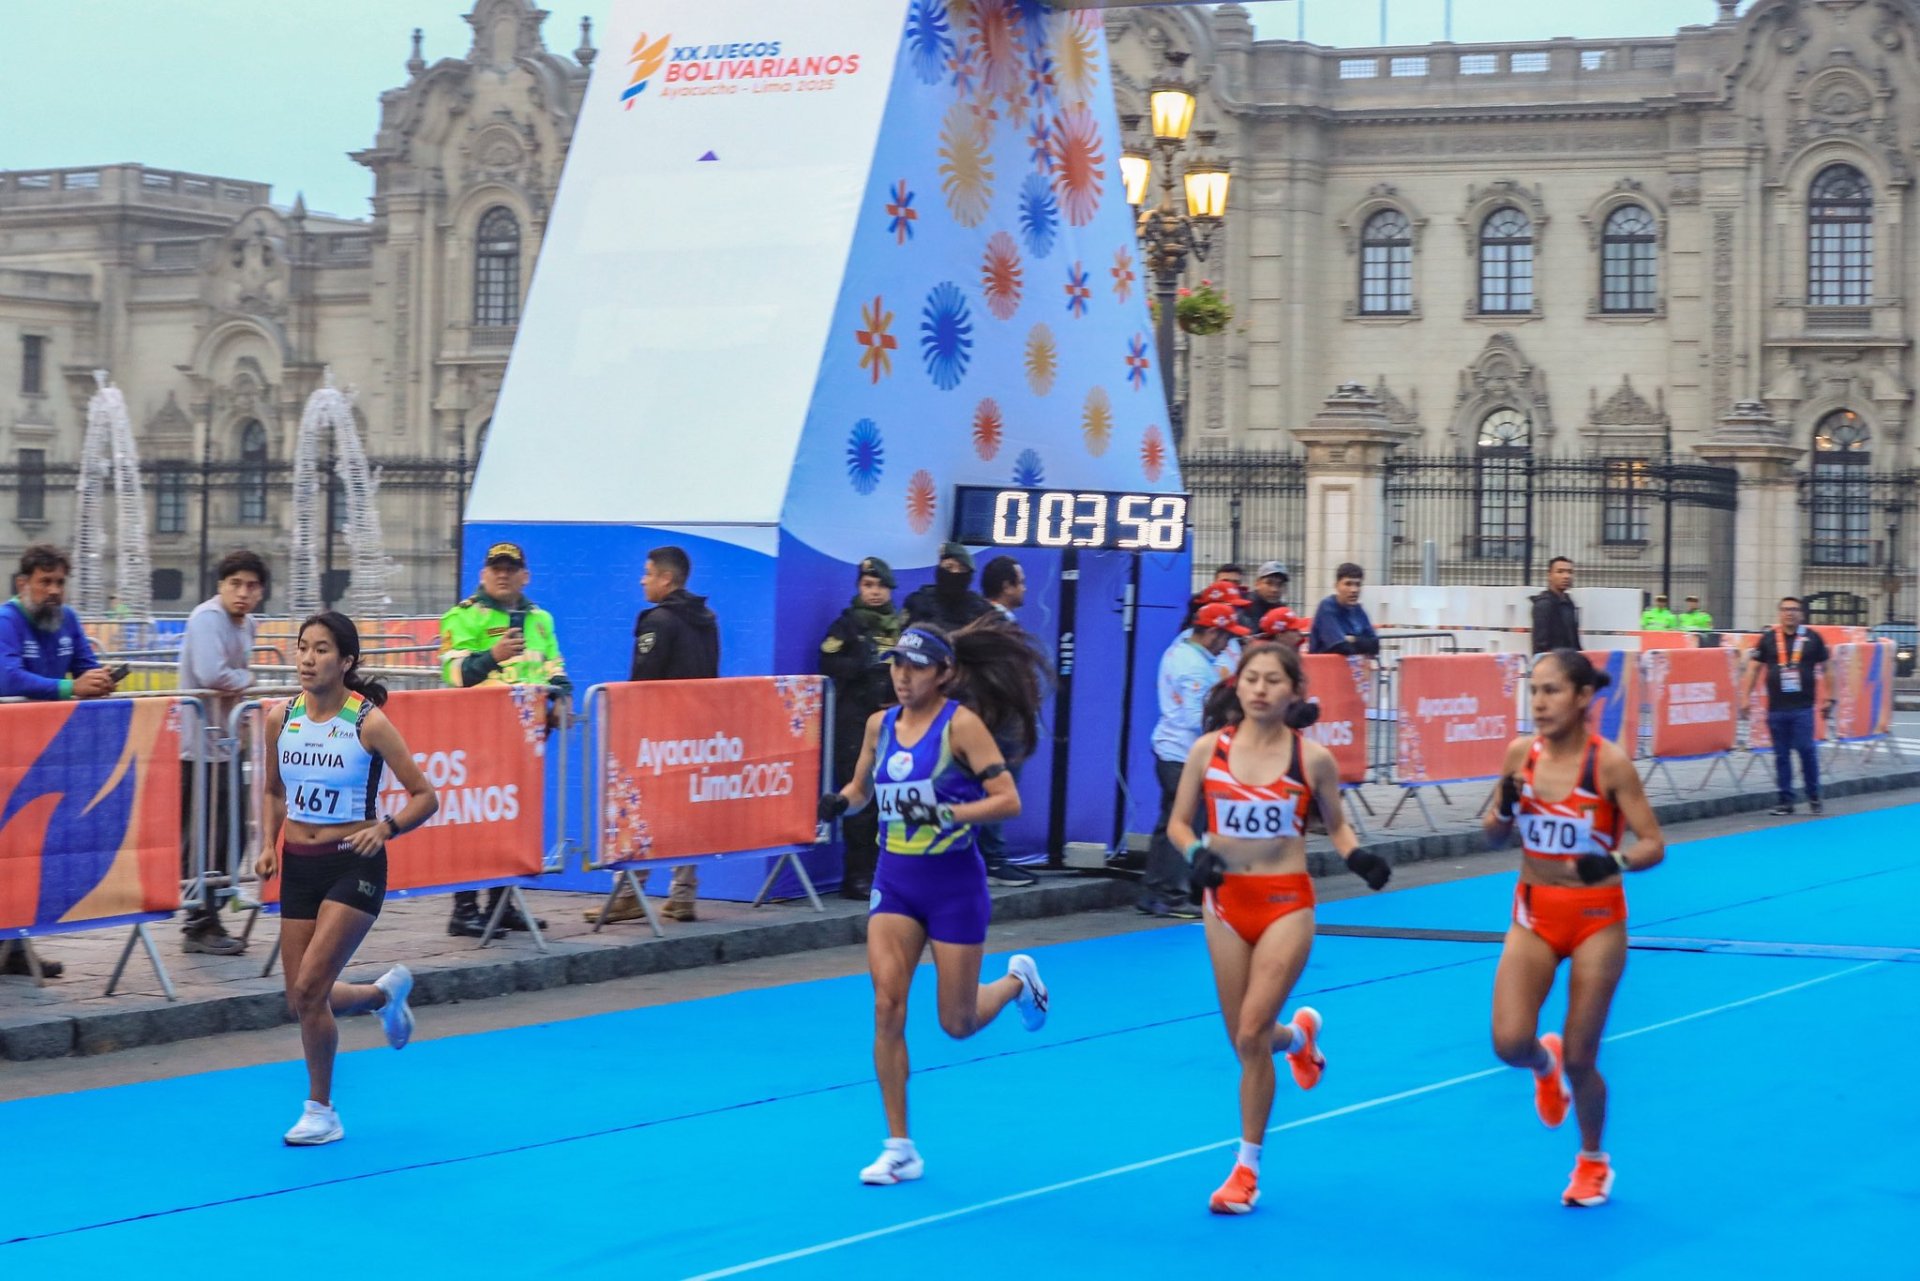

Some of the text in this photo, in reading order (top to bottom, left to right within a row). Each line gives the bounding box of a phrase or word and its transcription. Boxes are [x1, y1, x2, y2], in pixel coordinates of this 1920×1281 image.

[671, 46, 702, 61] XX
[664, 54, 860, 82] BOLIVARIANOS
[282, 750, 345, 769] BOLIVIA
[636, 731, 744, 776] Ayacucho
[294, 784, 340, 815] 467
[1225, 805, 1282, 833] 468
[1528, 820, 1576, 849] 470
